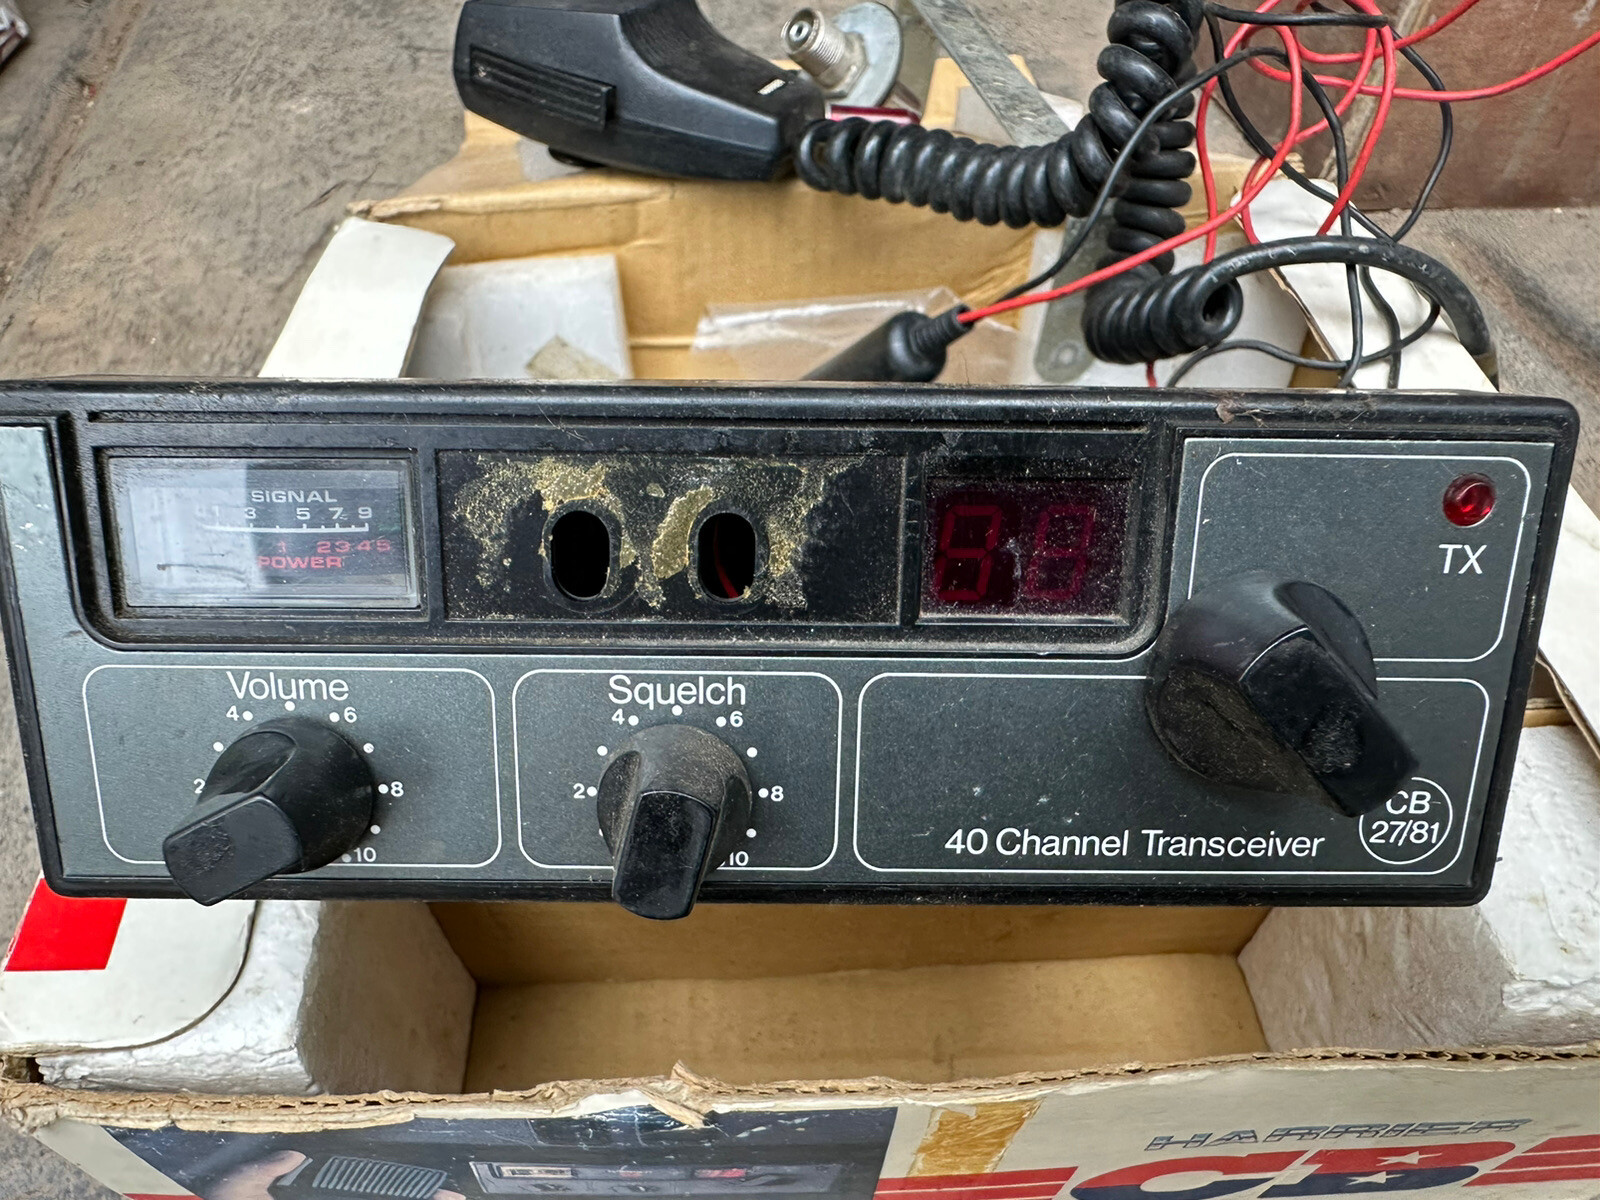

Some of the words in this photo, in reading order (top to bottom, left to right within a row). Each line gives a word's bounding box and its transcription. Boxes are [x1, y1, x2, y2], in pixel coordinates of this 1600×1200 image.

[251, 490, 338, 503] SIGNAL
[244, 507, 257, 519] 3
[296, 507, 311, 520] 5
[328, 507, 344, 520] 7
[358, 506, 373, 519] 9
[257, 556, 342, 569] POWER
[1438, 544, 1488, 575] TX
[226, 671, 349, 700] Volume
[608, 674, 747, 711] Squelch
[226, 706, 239, 721] 4
[344, 707, 357, 723] 6
[611, 709, 625, 725] 4
[729, 711, 743, 727] 6
[193, 779, 205, 794] 2
[390, 782, 404, 797] 8
[573, 784, 586, 799] 2
[770, 786, 784, 802] 8
[1386, 790, 1431, 814] CB
[1368, 819, 1440, 847] 27/81
[945, 829, 988, 855] 40
[995, 828, 1129, 857] Channel
[1141, 830, 1326, 858] Transceiver
[354, 847, 376, 862] 10
[729, 851, 749, 866] 10
[1144, 1118, 1532, 1151] HARRIER
